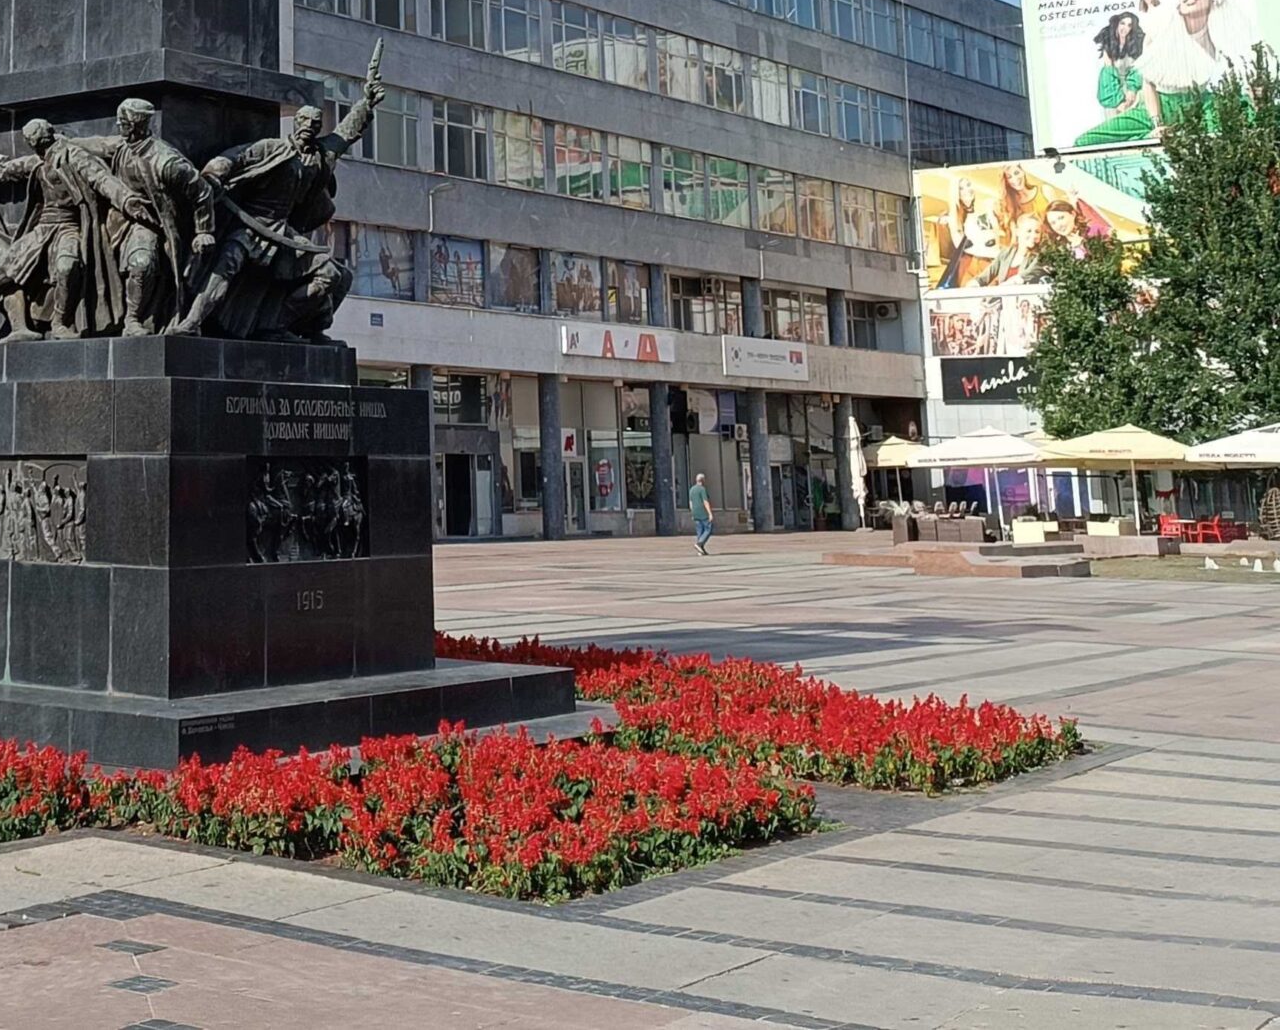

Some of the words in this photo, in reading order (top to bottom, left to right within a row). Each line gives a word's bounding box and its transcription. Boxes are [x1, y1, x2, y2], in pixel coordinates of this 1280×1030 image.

[1103, 1, 1136, 13] KOSA
[961, 359, 1029, 398] Manila
[278, 398, 291, 416] ЗА
[359, 401, 387, 419] НИША
